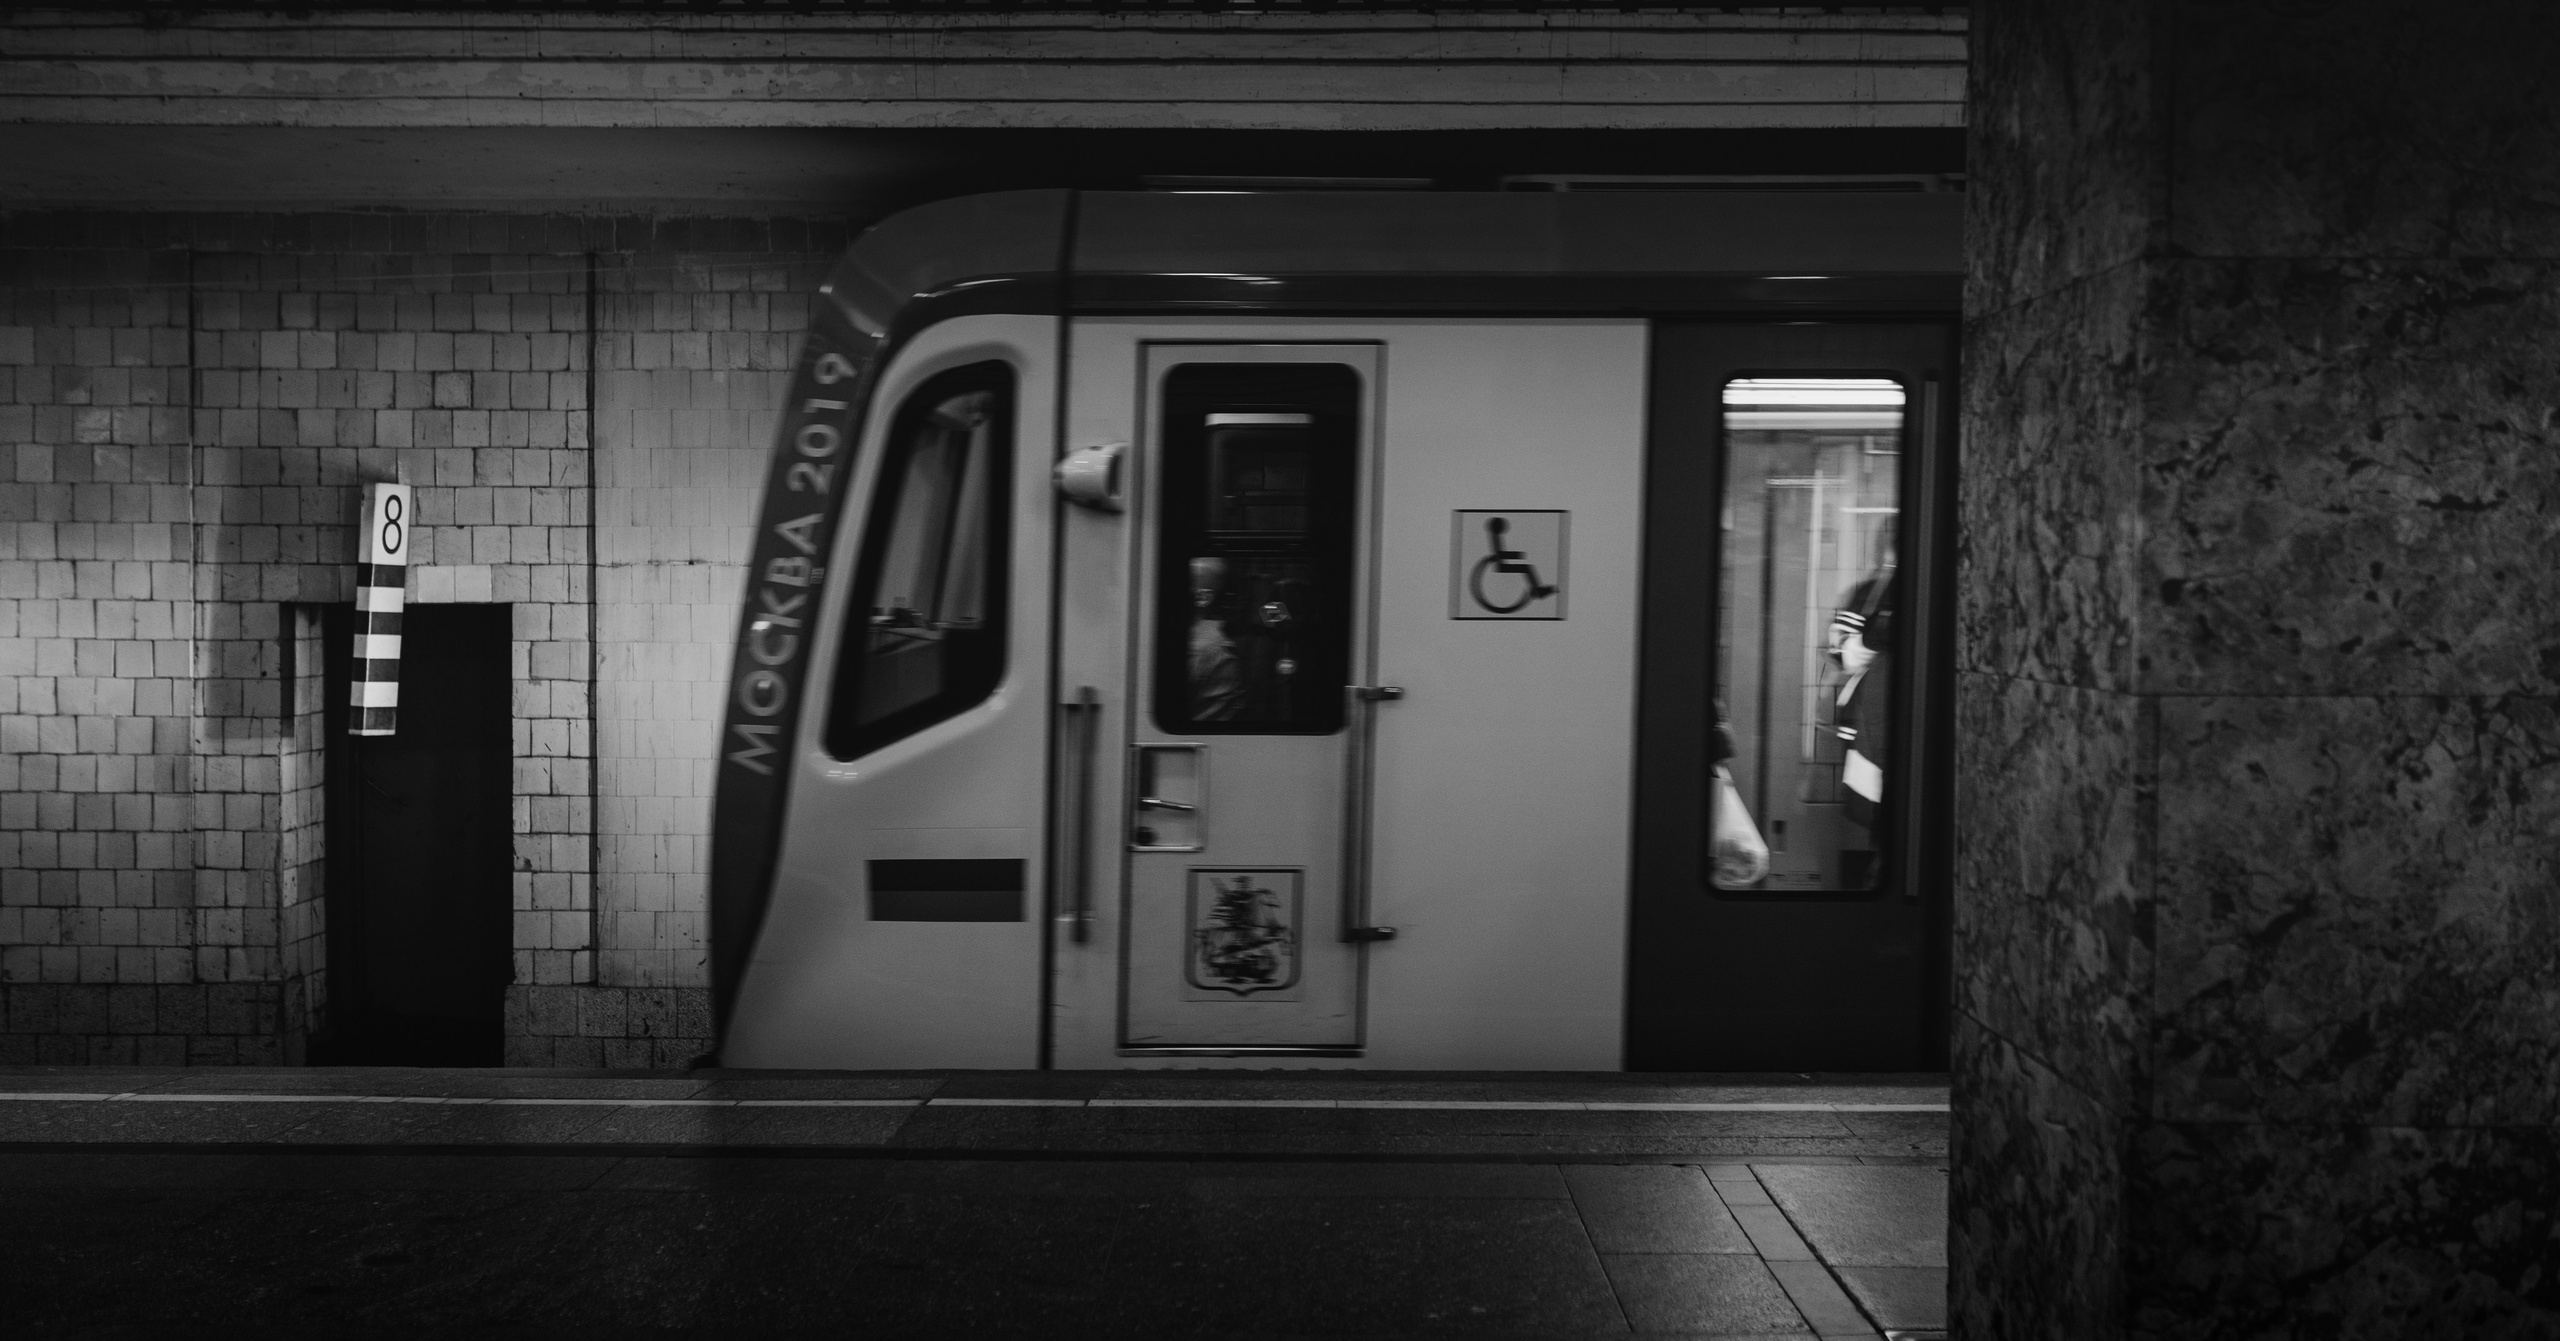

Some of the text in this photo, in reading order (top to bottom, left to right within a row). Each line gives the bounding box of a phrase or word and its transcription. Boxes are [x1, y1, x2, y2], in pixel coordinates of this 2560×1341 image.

[382, 494, 402, 555] 8
[726, 352, 858, 776] МОСКВА 2019
